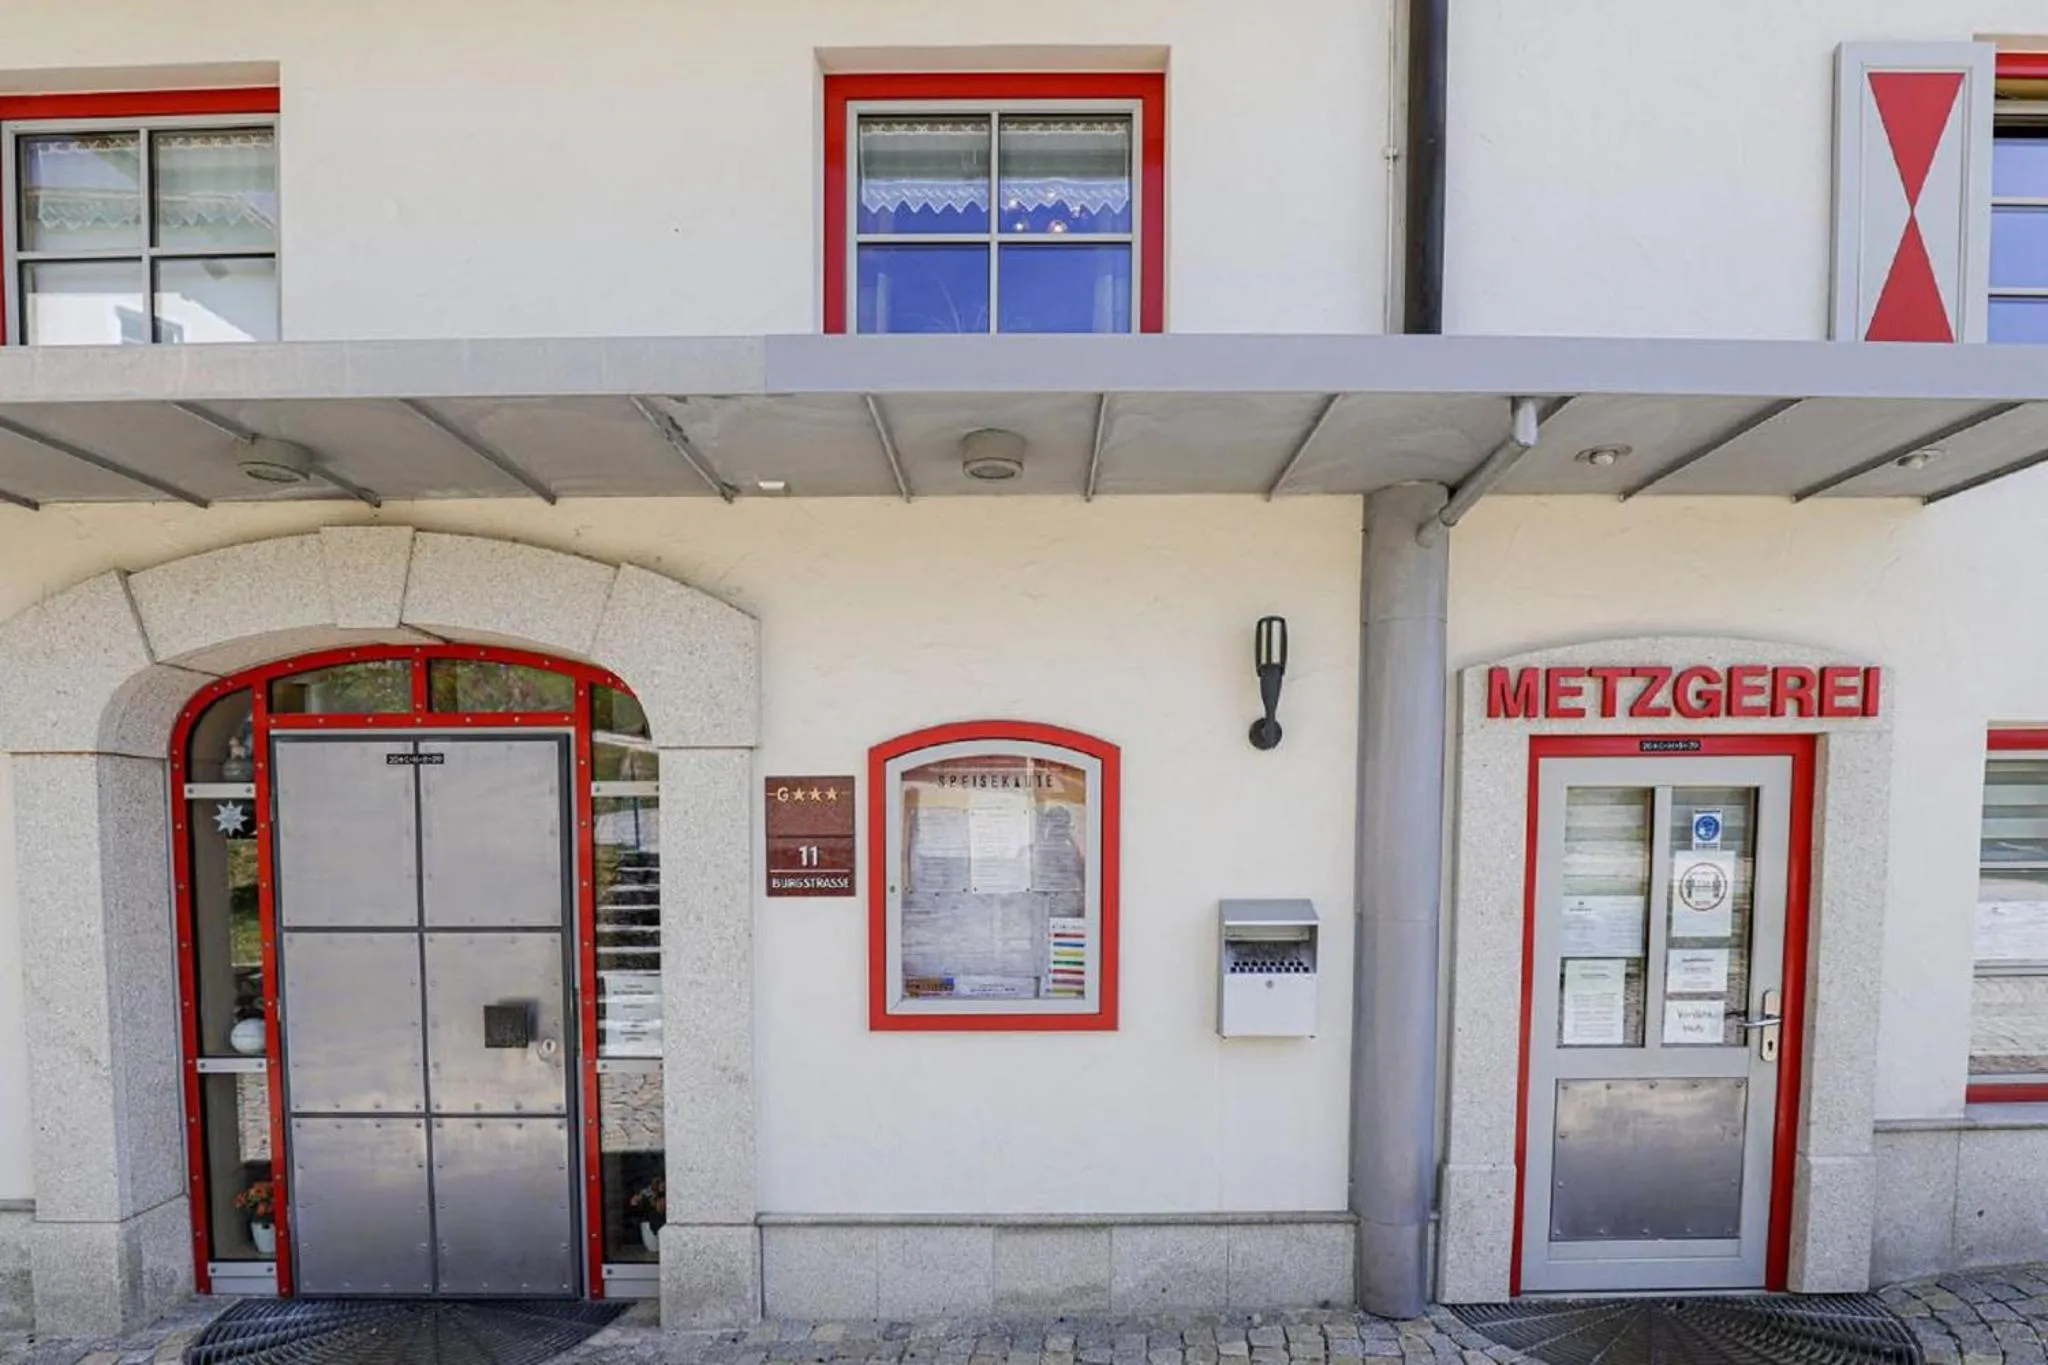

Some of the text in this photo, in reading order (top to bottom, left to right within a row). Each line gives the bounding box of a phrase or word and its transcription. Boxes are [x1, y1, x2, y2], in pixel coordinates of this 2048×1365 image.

[1487, 665, 1881, 719] METZGEREI
[798, 845, 819, 867] 11
[772, 877, 849, 888] BURGSTRASSE
